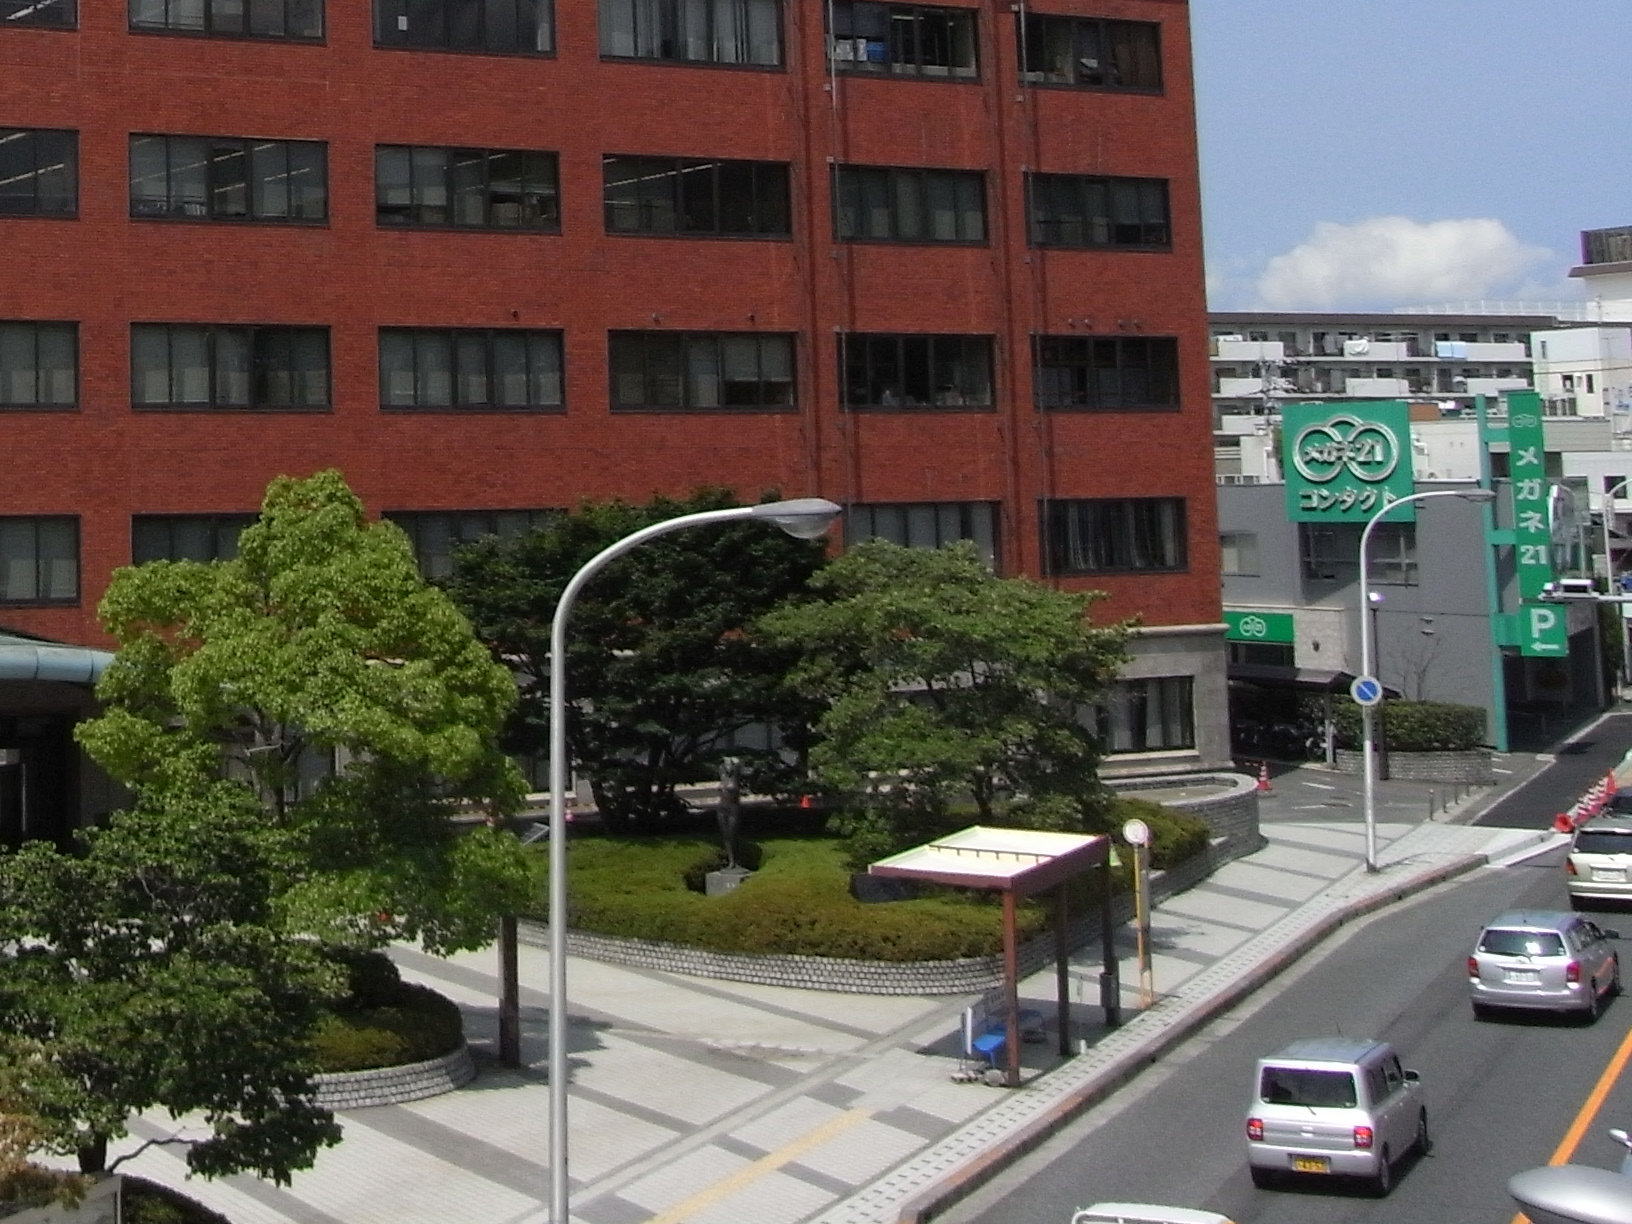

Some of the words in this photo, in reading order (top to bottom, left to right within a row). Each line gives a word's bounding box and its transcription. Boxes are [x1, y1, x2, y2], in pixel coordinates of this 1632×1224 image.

[1299, 486, 1397, 510] コンタクト
[1516, 446, 1547, 564] メガネ21
[1530, 608, 1556, 638] P
